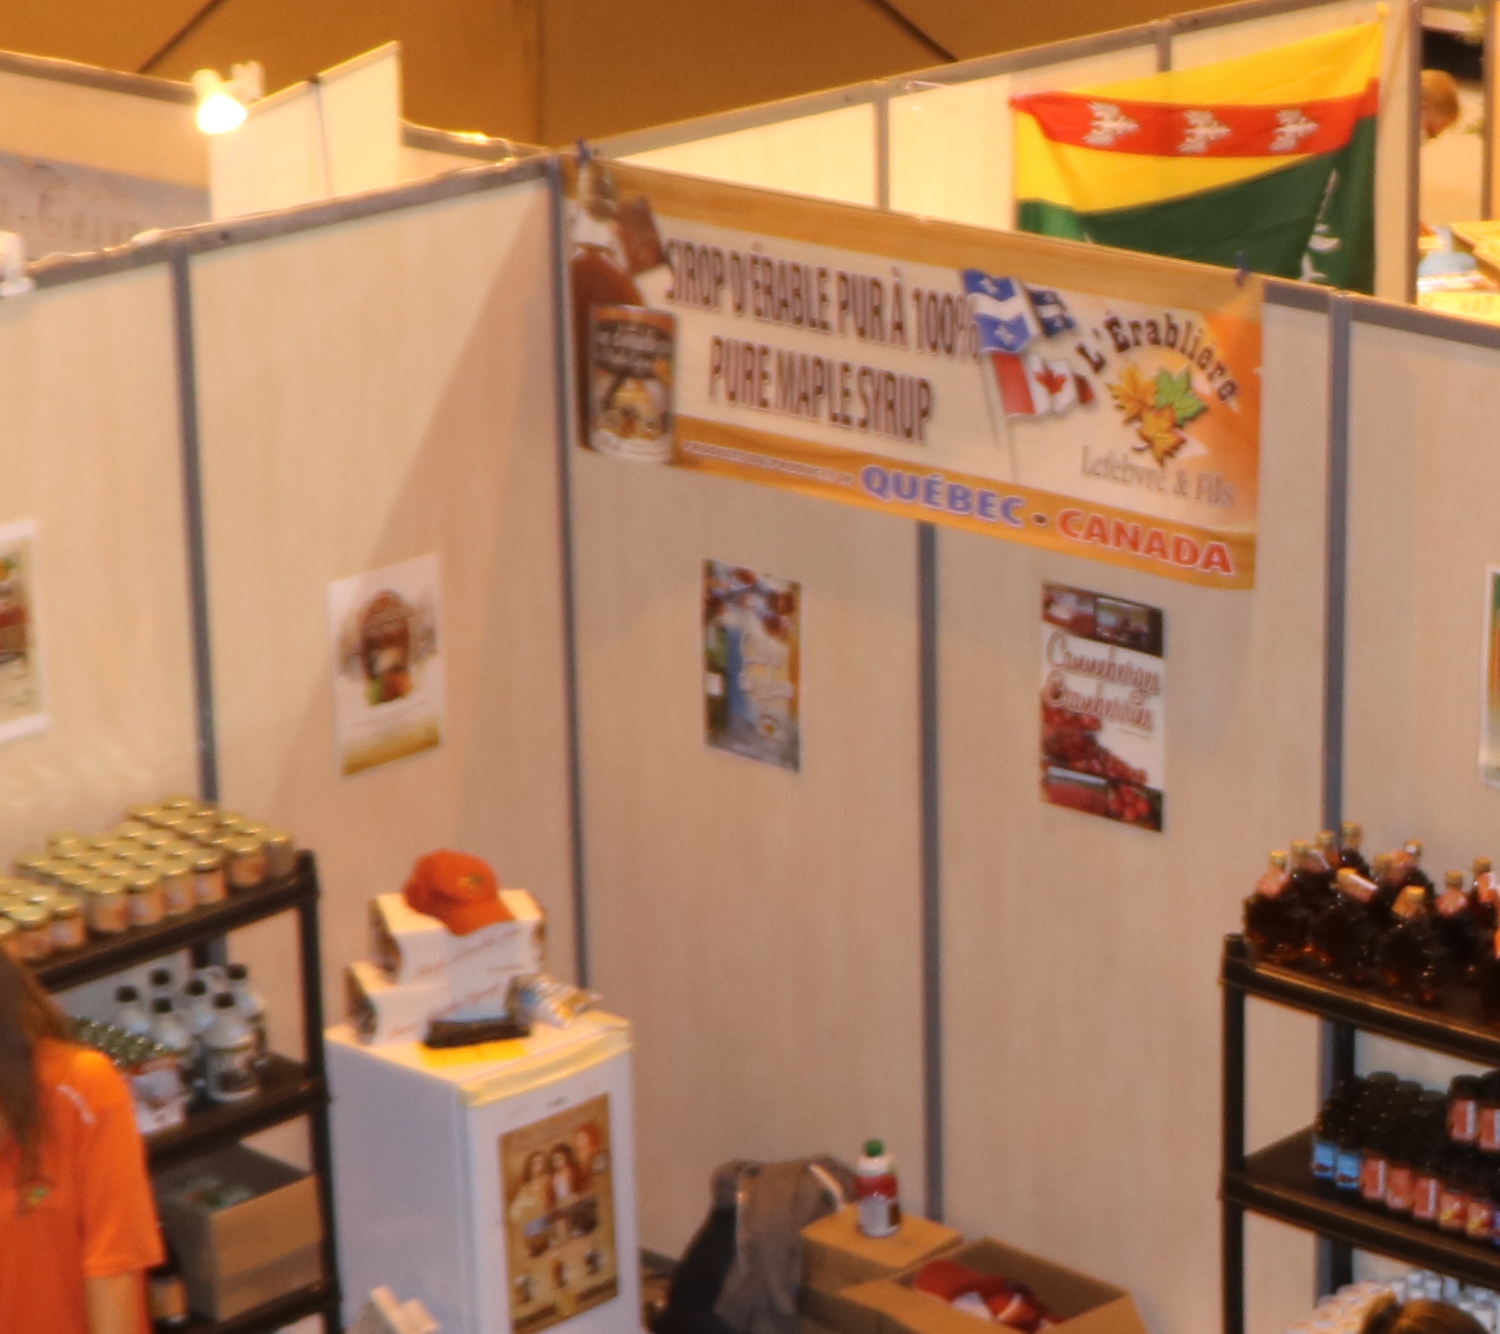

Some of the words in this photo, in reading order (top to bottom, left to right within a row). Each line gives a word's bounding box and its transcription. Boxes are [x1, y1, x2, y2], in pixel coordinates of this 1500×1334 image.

[665, 238, 727, 312] SIROP
[729, 240, 831, 335] D'ÉRABLE
[836, 269, 884, 343] PUR
[708, 335, 771, 411] PURE
[774, 347, 853, 428] MAPLE
[857, 364, 933, 444] SYRUP
[860, 463, 1027, 528] QUÉBEC
[1057, 507, 1235, 577] CANADA
[1172, 469, 1189, 497] &
[1195, 471, 1235, 508] Fils
